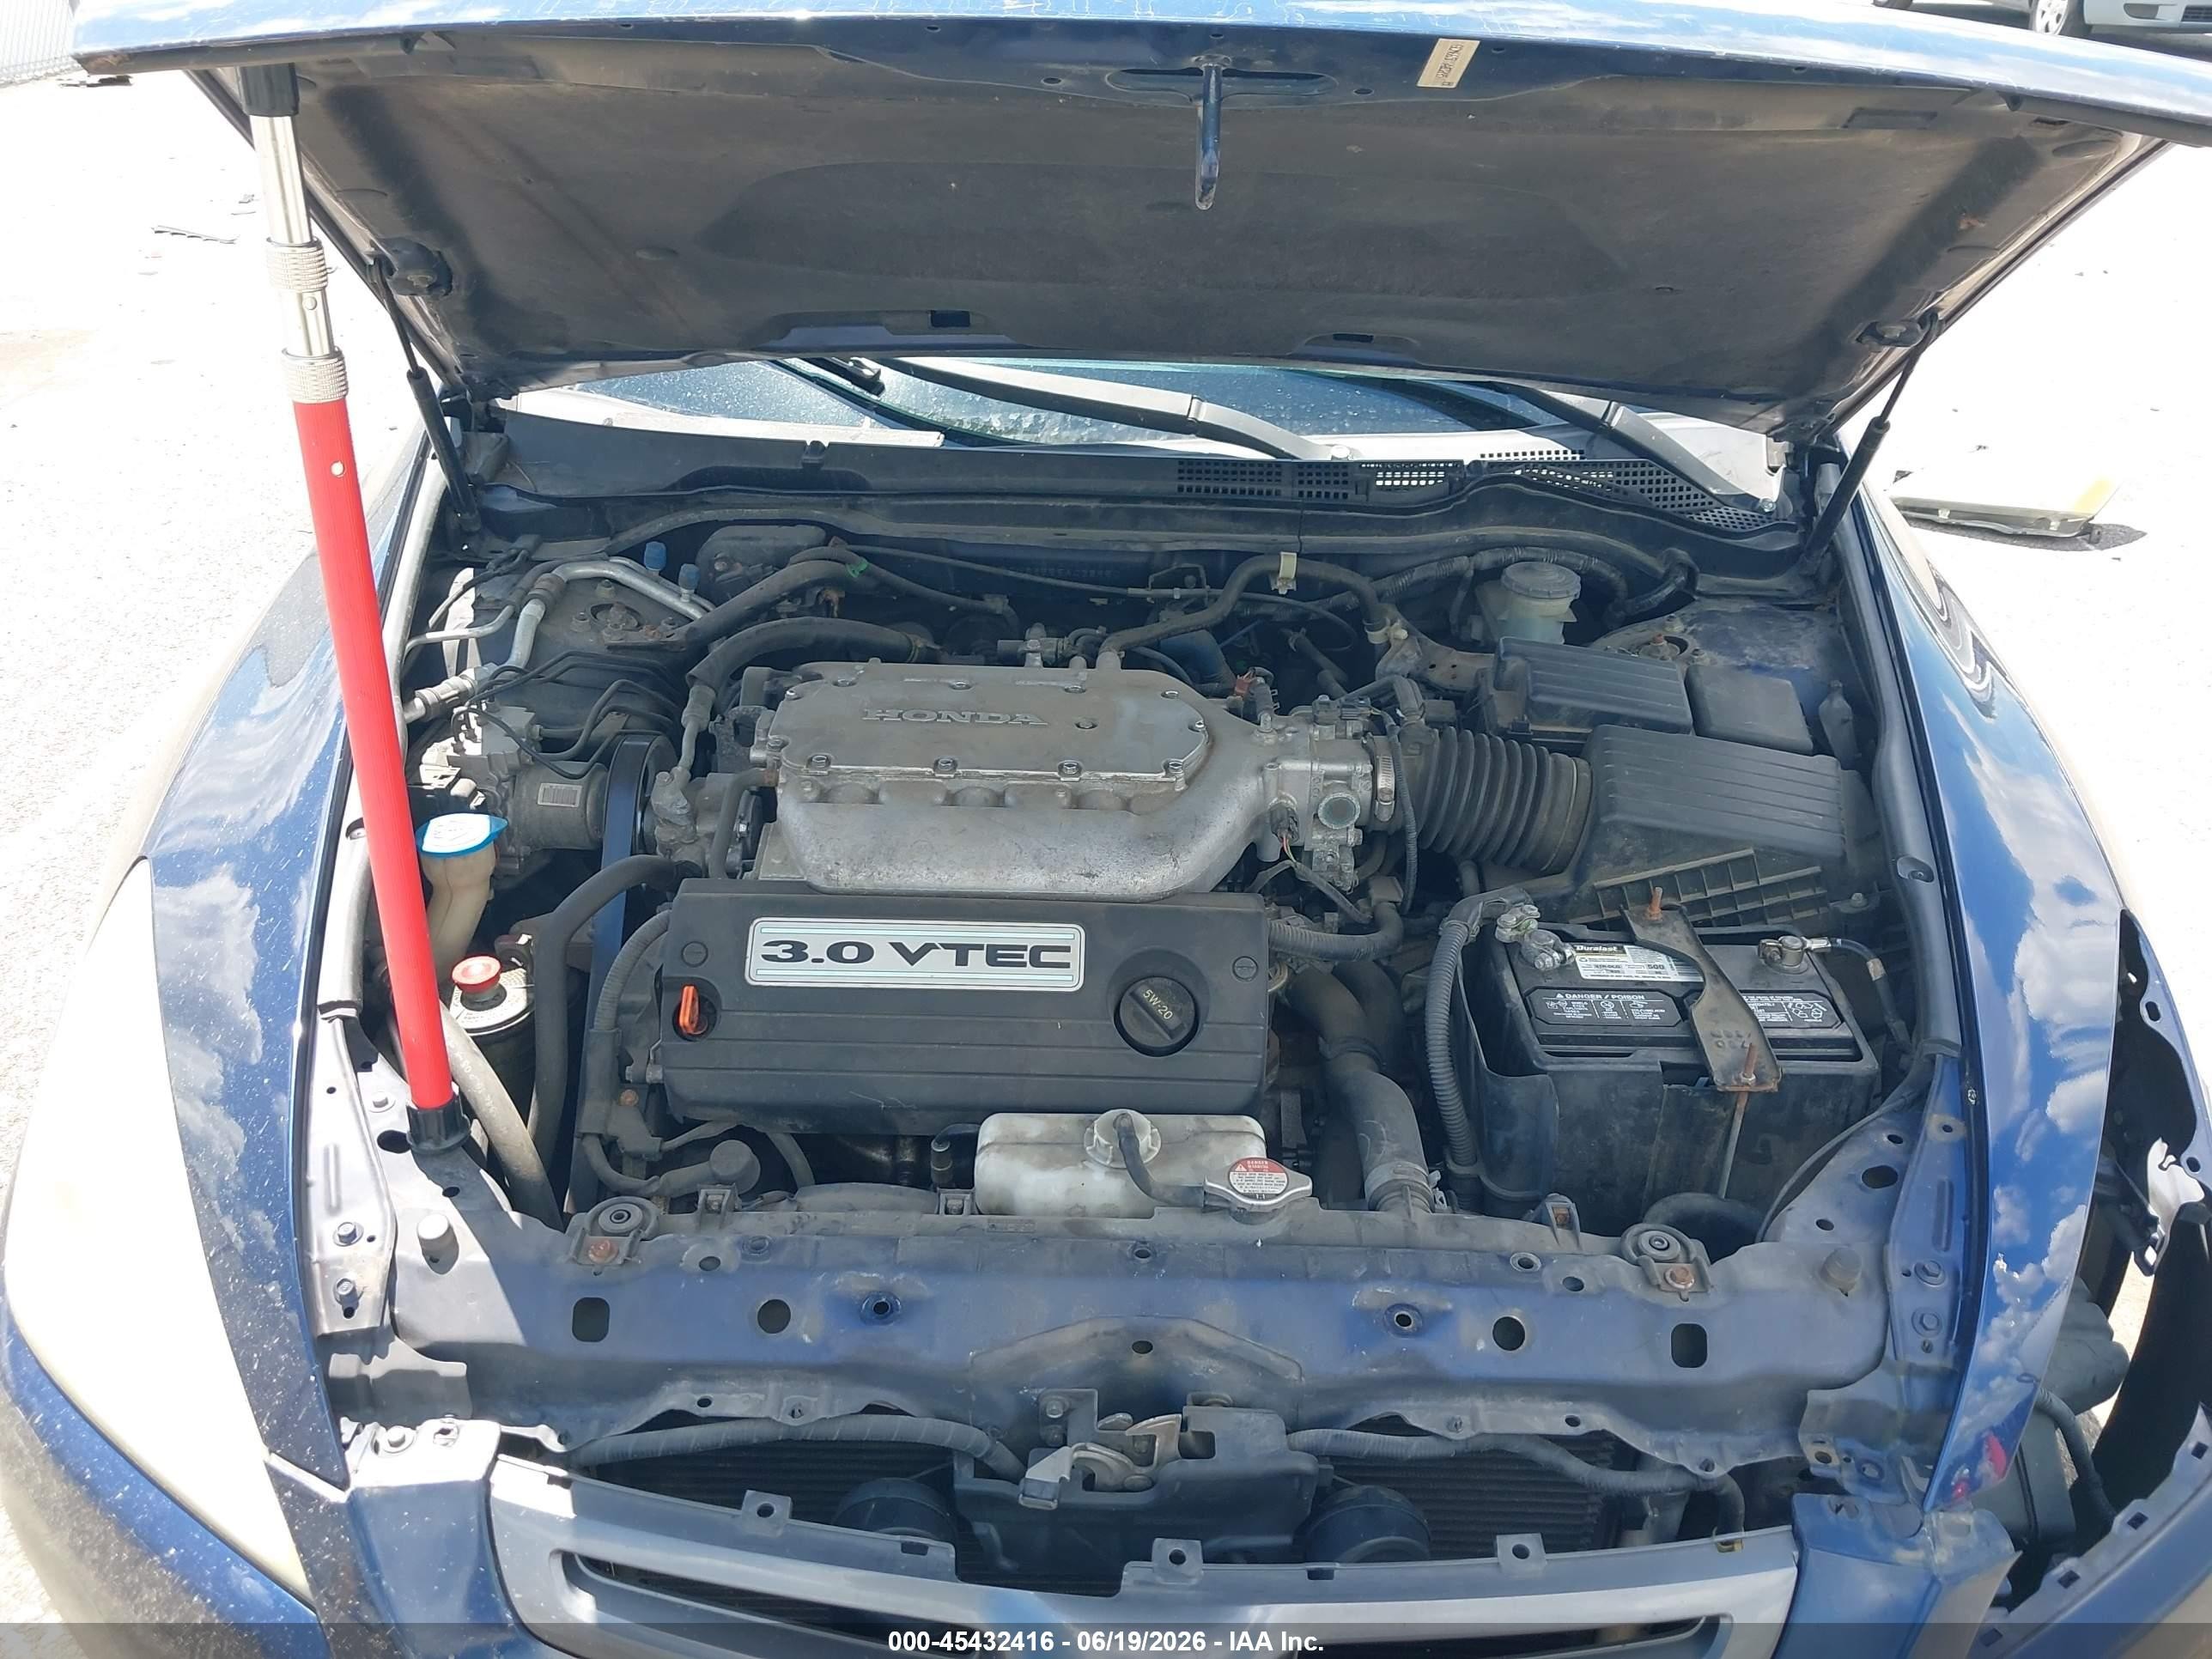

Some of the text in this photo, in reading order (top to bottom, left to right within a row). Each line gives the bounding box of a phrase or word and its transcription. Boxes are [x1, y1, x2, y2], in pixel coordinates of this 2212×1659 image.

[862, 708, 1048, 726] HONDA
[761, 940, 1072, 969] 3.0 VTEC
[1143, 989, 1173, 1020] 5W-20
